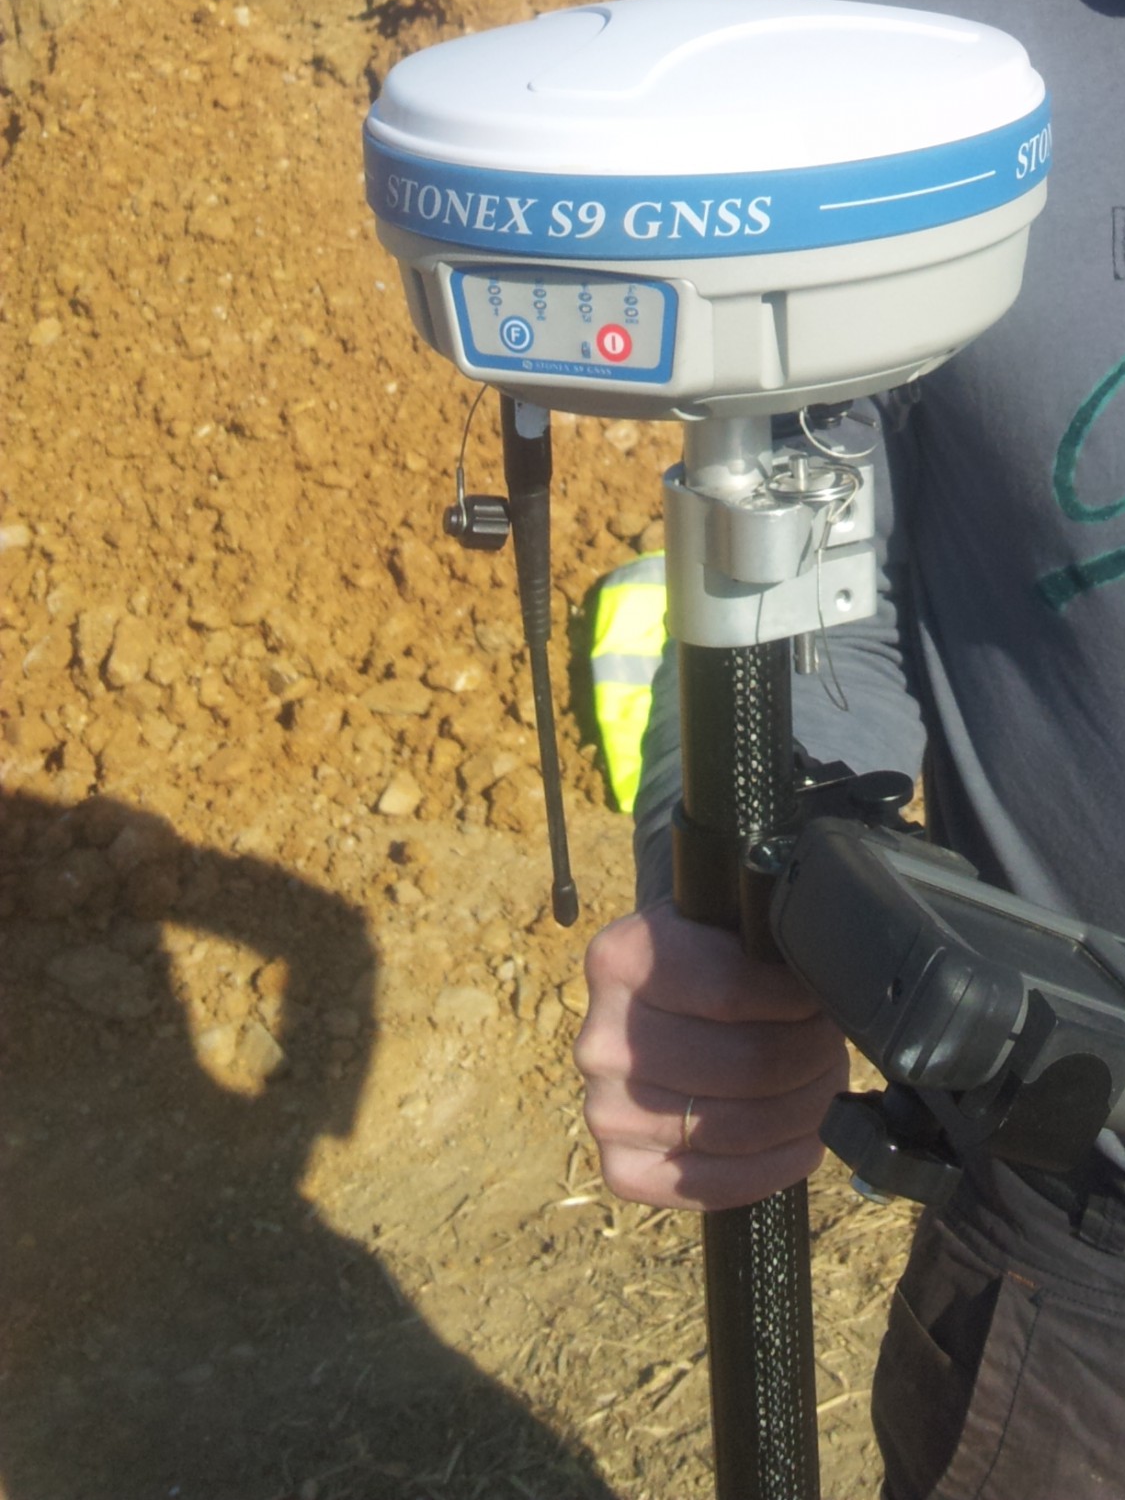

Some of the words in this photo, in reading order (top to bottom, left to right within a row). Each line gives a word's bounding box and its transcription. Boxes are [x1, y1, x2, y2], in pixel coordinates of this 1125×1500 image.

[386, 174, 539, 236] STONEX
[548, 200, 607, 240] S9
[623, 196, 773, 240] GNSS
[510, 326, 521, 343] F
